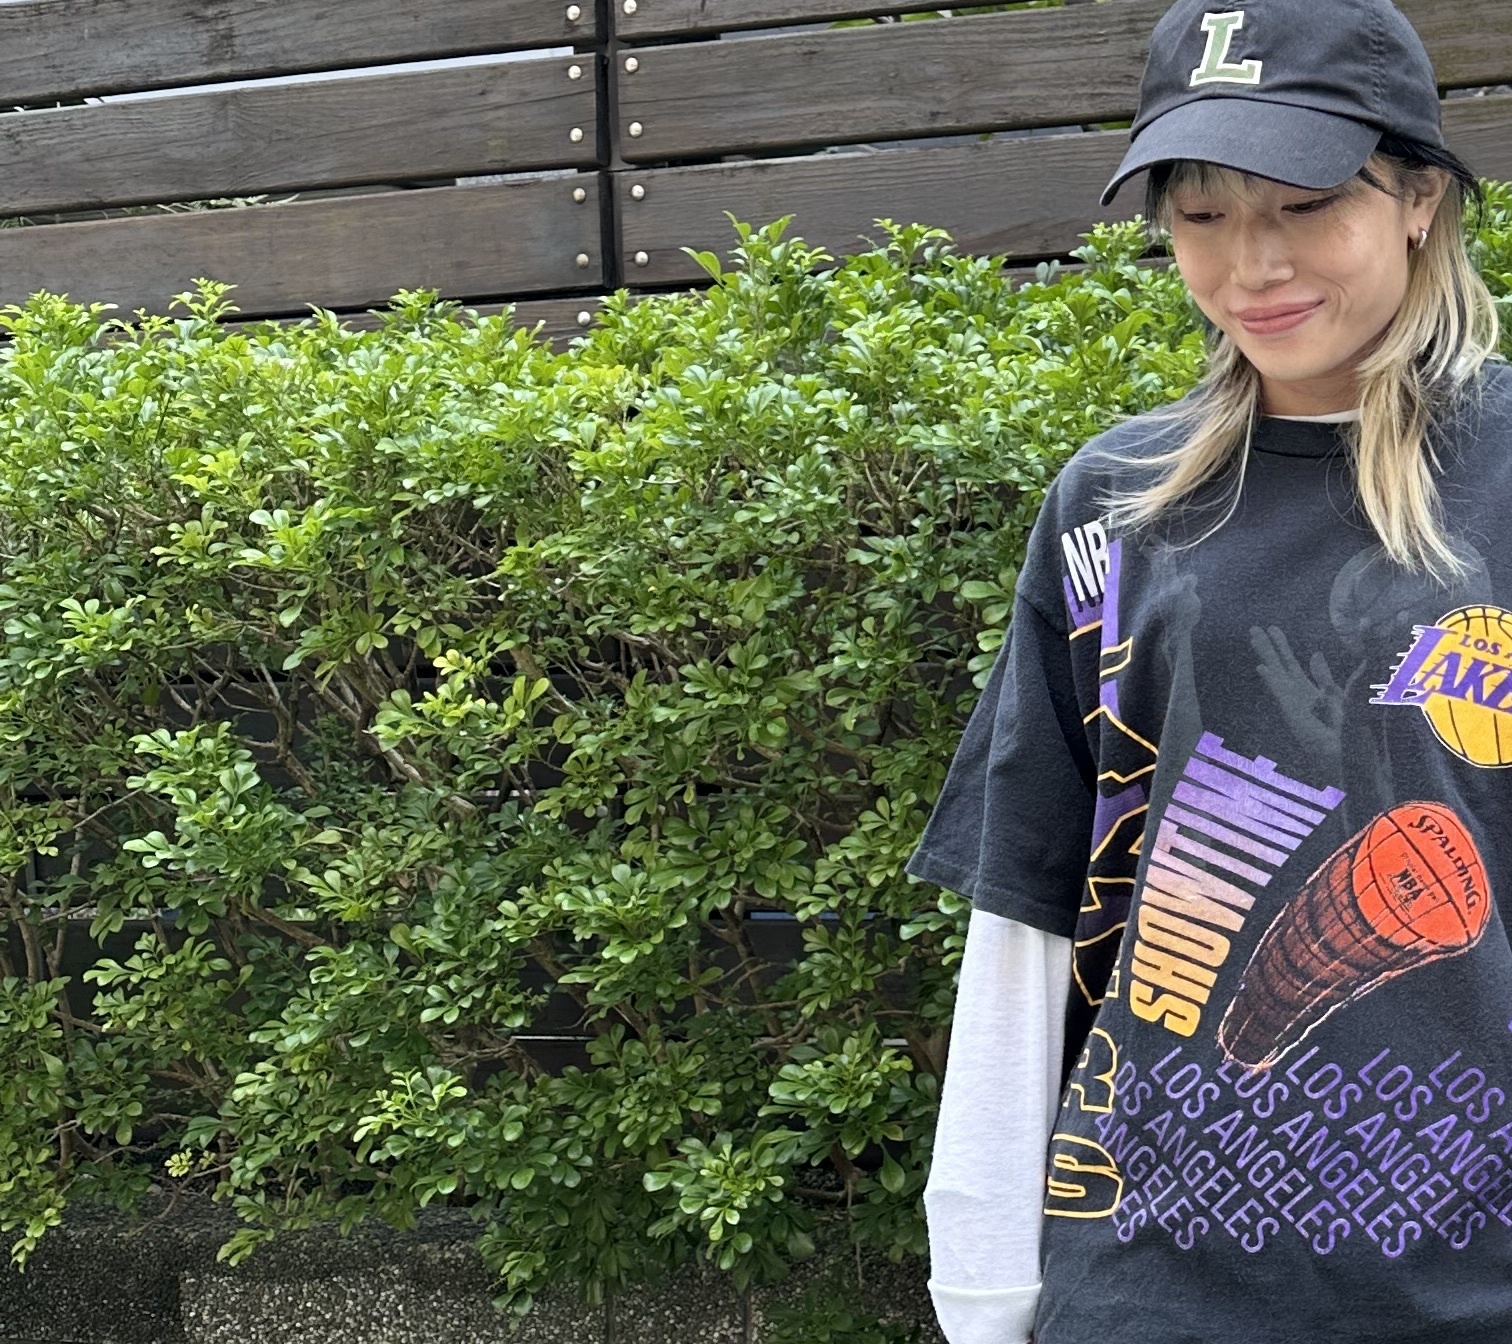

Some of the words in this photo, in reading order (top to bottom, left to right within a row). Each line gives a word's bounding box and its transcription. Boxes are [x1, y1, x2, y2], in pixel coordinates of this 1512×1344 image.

[1189, 10, 1263, 87] L
[1458, 633, 1503, 656] LOS
[1130, 730, 1347, 1038] SHOWTIME
[1394, 867, 1427, 902] NBA
[1407, 814, 1482, 912] SPALDING
[1357, 1047, 1434, 1122] LOS
[1428, 1049, 1506, 1124] LOS
[1094, 1108, 1210, 1251] ANGELES
[1114, 1043, 1153, 1116] OS
[1142, 1109, 1281, 1254] ANGELES
[1149, 1045, 1221, 1119] LOS
[1202, 1109, 1351, 1255] ANGELES
[1272, 1110, 1423, 1258] ANGELES
[1285, 1045, 1363, 1120] LOS
[1344, 1111, 1487, 1250] ANGELES
